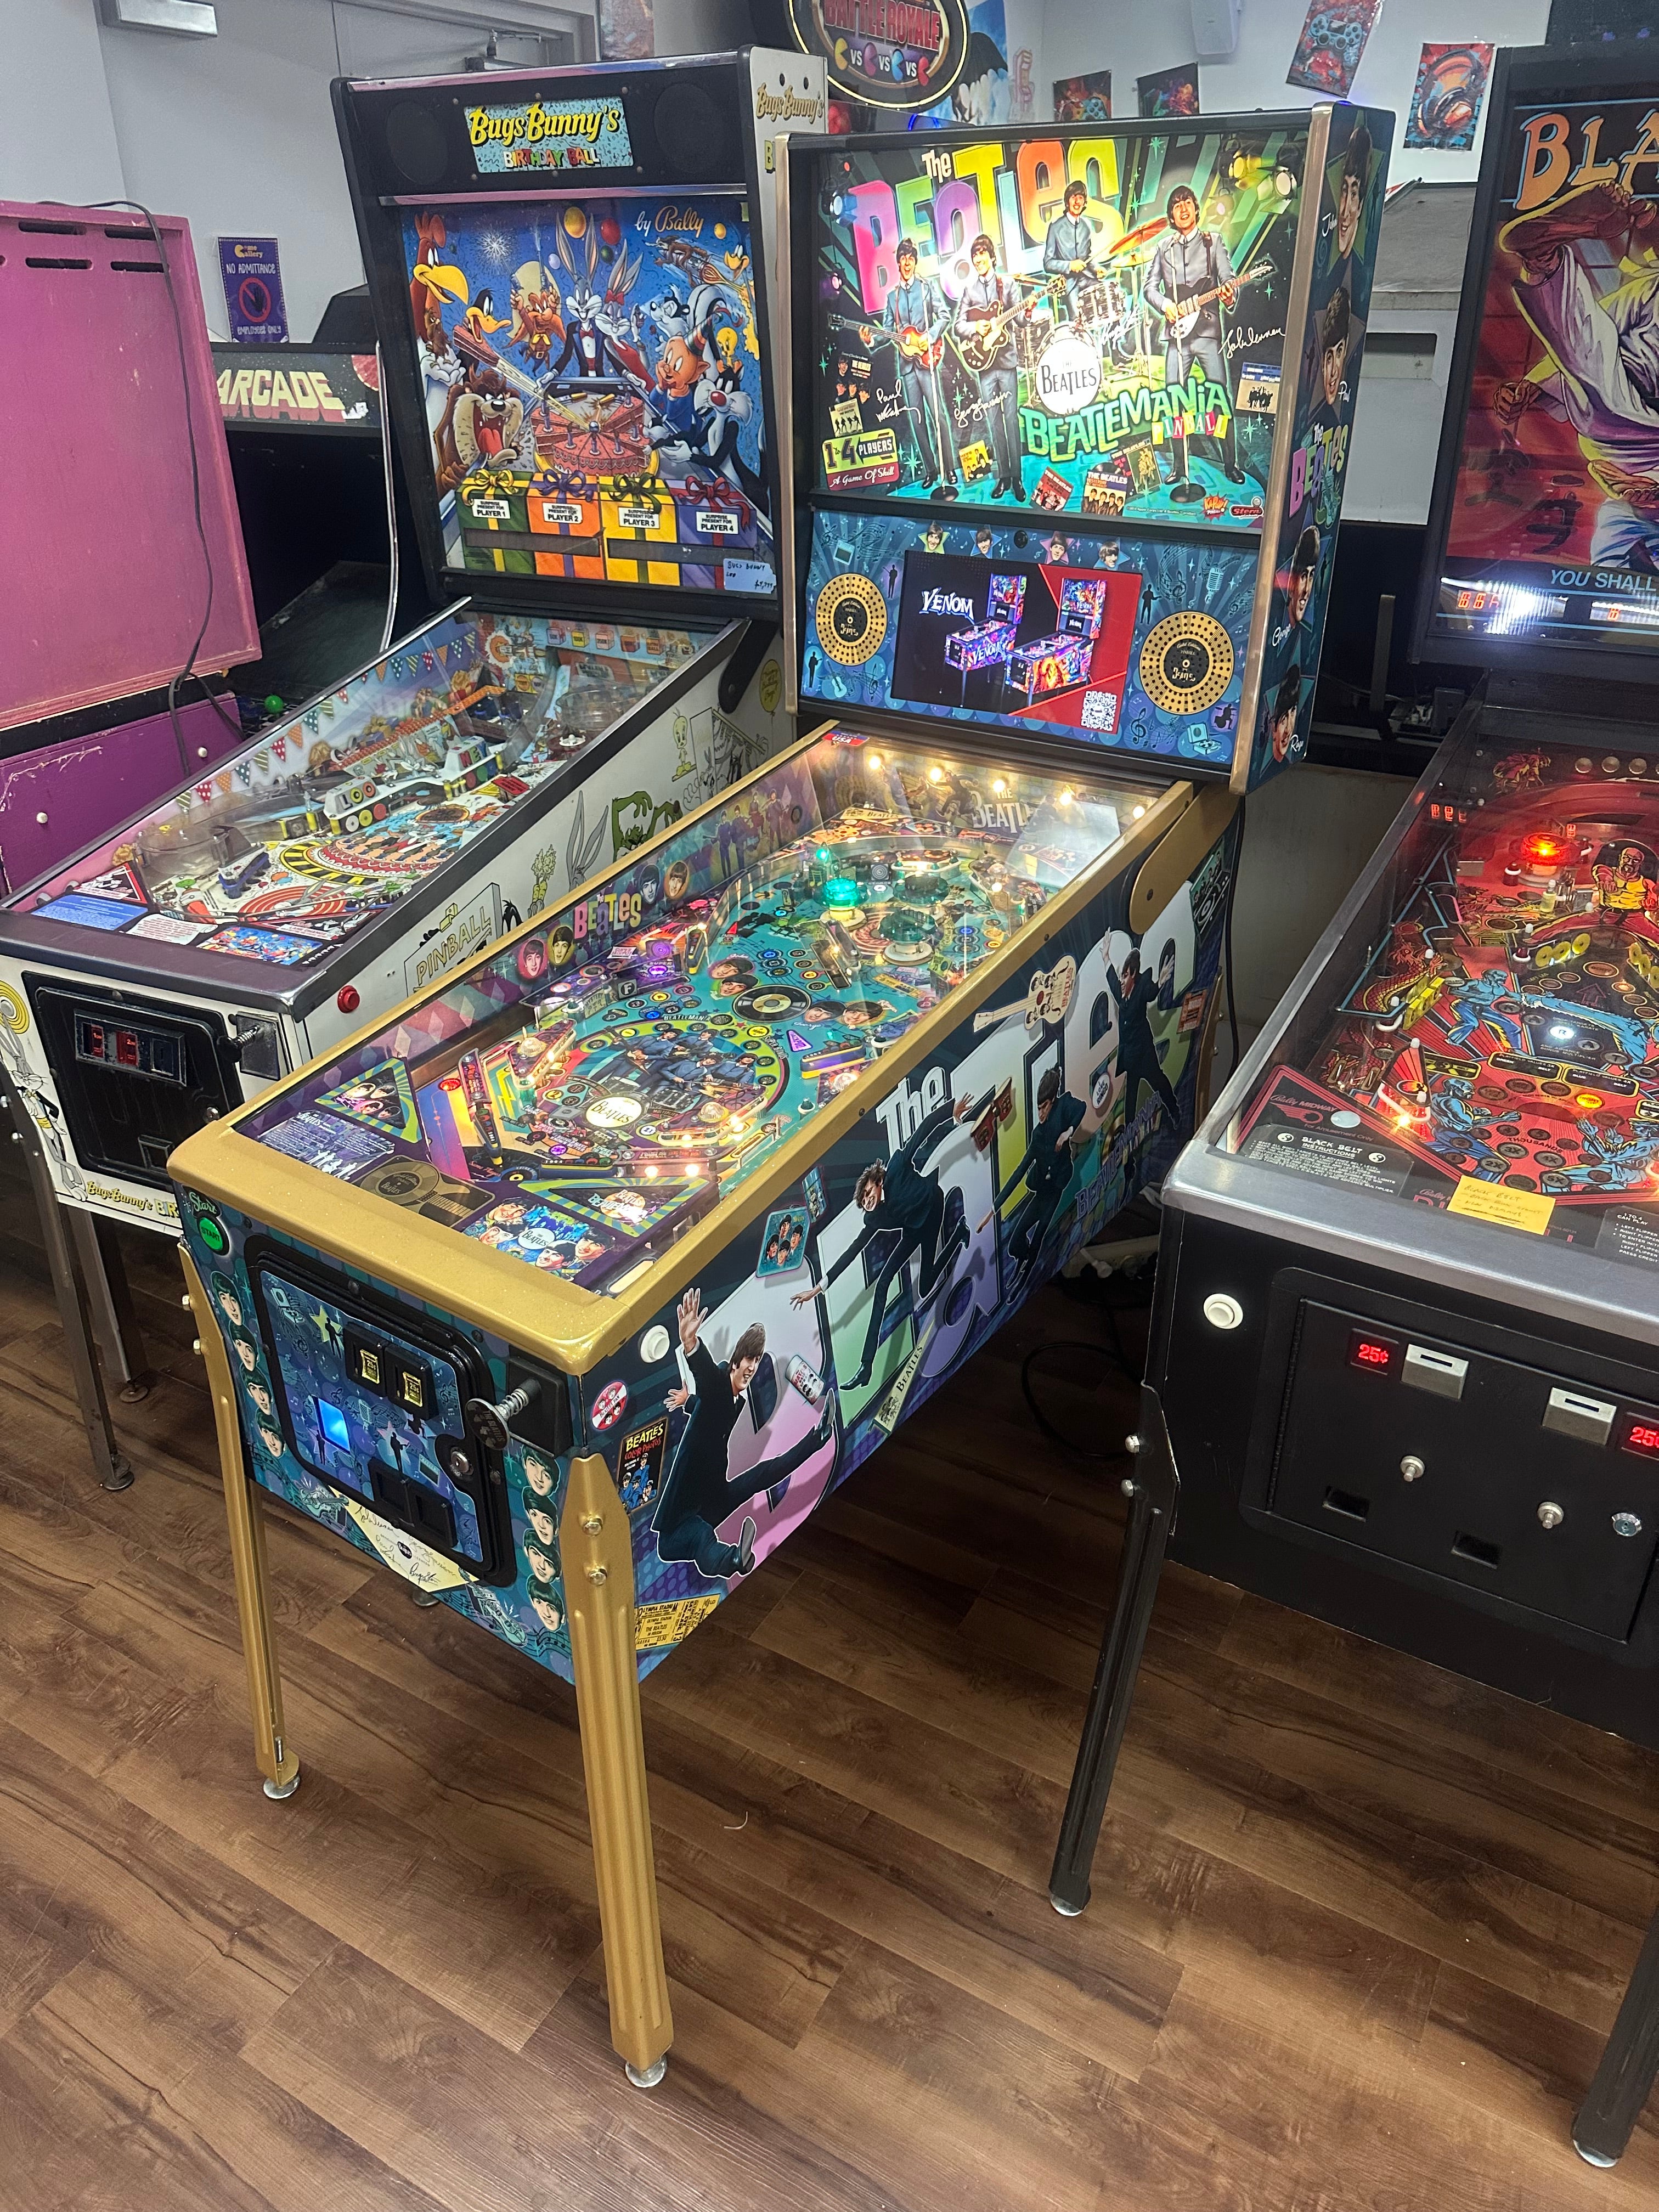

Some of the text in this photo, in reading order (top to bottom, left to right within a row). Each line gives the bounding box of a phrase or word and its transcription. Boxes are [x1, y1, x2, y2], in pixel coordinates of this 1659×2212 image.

[885, 5, 940, 52] ROYALE
[850, 49, 917, 78] VS VS VS
[757, 82, 824, 125] Bugs Bunny's
[469, 101, 622, 147] Bugs Bunny's
[503, 146, 601, 168] BIRTHDAY BALL
[922, 149, 952, 183] The
[634, 205, 704, 238] by Bally
[226, 263, 276, 274] NO ADMITTANCE
[267, 325, 281, 334] ONLY
[1041, 365, 1097, 396] BEATLES
[217, 369, 346, 417] ARCADE
[1019, 377, 1232, 463] BEATLEMANIA
[1154, 413, 1227, 440] PINBALL
[825, 438, 893, 469] 1 4 PLAYERS
[842, 475, 863, 486] Game
[864, 469, 878, 483] Of
[877, 466, 895, 479] Skill
[1088, 471, 1128, 484] THE BEATLES
[1551, 570, 1658, 591] YOU SHALL
[919, 587, 975, 624] VENOM
[973, 641, 1000, 665] VENOM
[832, 736, 851, 744] USA
[416, 906, 492, 986] PINBALL
[1061, 967, 1074, 1008] BEATLES
[764, 1035, 789, 1059] SUPER BONUS
[1097, 1080, 1105, 1096] LOVE
[1097, 1084, 1109, 1105] RINGO
[591, 1101, 634, 1123] BEATLES
[876, 1066, 946, 1159] The
[1269, 1094, 1339, 1112] Bally MIDWAY
[298, 1113, 321, 1125] BEATLES
[1316, 1126, 1356, 1138] Amusement
[1357, 1133, 1374, 1142] Only
[1301, 1136, 1363, 1154] BLACK BELT
[1301, 1143, 1356, 1158] INSTRUCTIONS
[1504, 1146, 1521, 1154] 3X
[1507, 1137, 1563, 1153] THOUSANDS
[1485, 1160, 1502, 1169] 2X
[1542, 1155, 1559, 1164] 4X
[381, 1182, 401, 1194] BEATLES
[1547, 1175, 1564, 1184] 5X
[87, 1180, 112, 1199] Bugs
[111, 1188, 153, 1211] Bunny's
[189, 1192, 218, 1214] Start
[1420, 1189, 1444, 1200] Bally
[1496, 1193, 1522, 1201] BELT
[201, 1228, 220, 1242] START
[523, 1231, 556, 1248] BEATLES
[1636, 1228, 1658, 1237] FLIPPER
[1635, 1248, 1658, 1258] FLIPPER
[1638, 1253, 1658, 1263] CREDIT
[1358, 1344, 1389, 1364] 25¢
[366, 1360, 376, 1371] 25¢
[896, 1346, 923, 1392] BEATLES
[409, 1382, 420, 1394] 25¢
[483, 1410, 506, 1443] THE BEATLES
[626, 1423, 663, 1452] BEATLES
[624, 1436, 661, 1460] COLOR PHOTOS
[638, 1602, 679, 1617] OLYMPIA STADIUM
